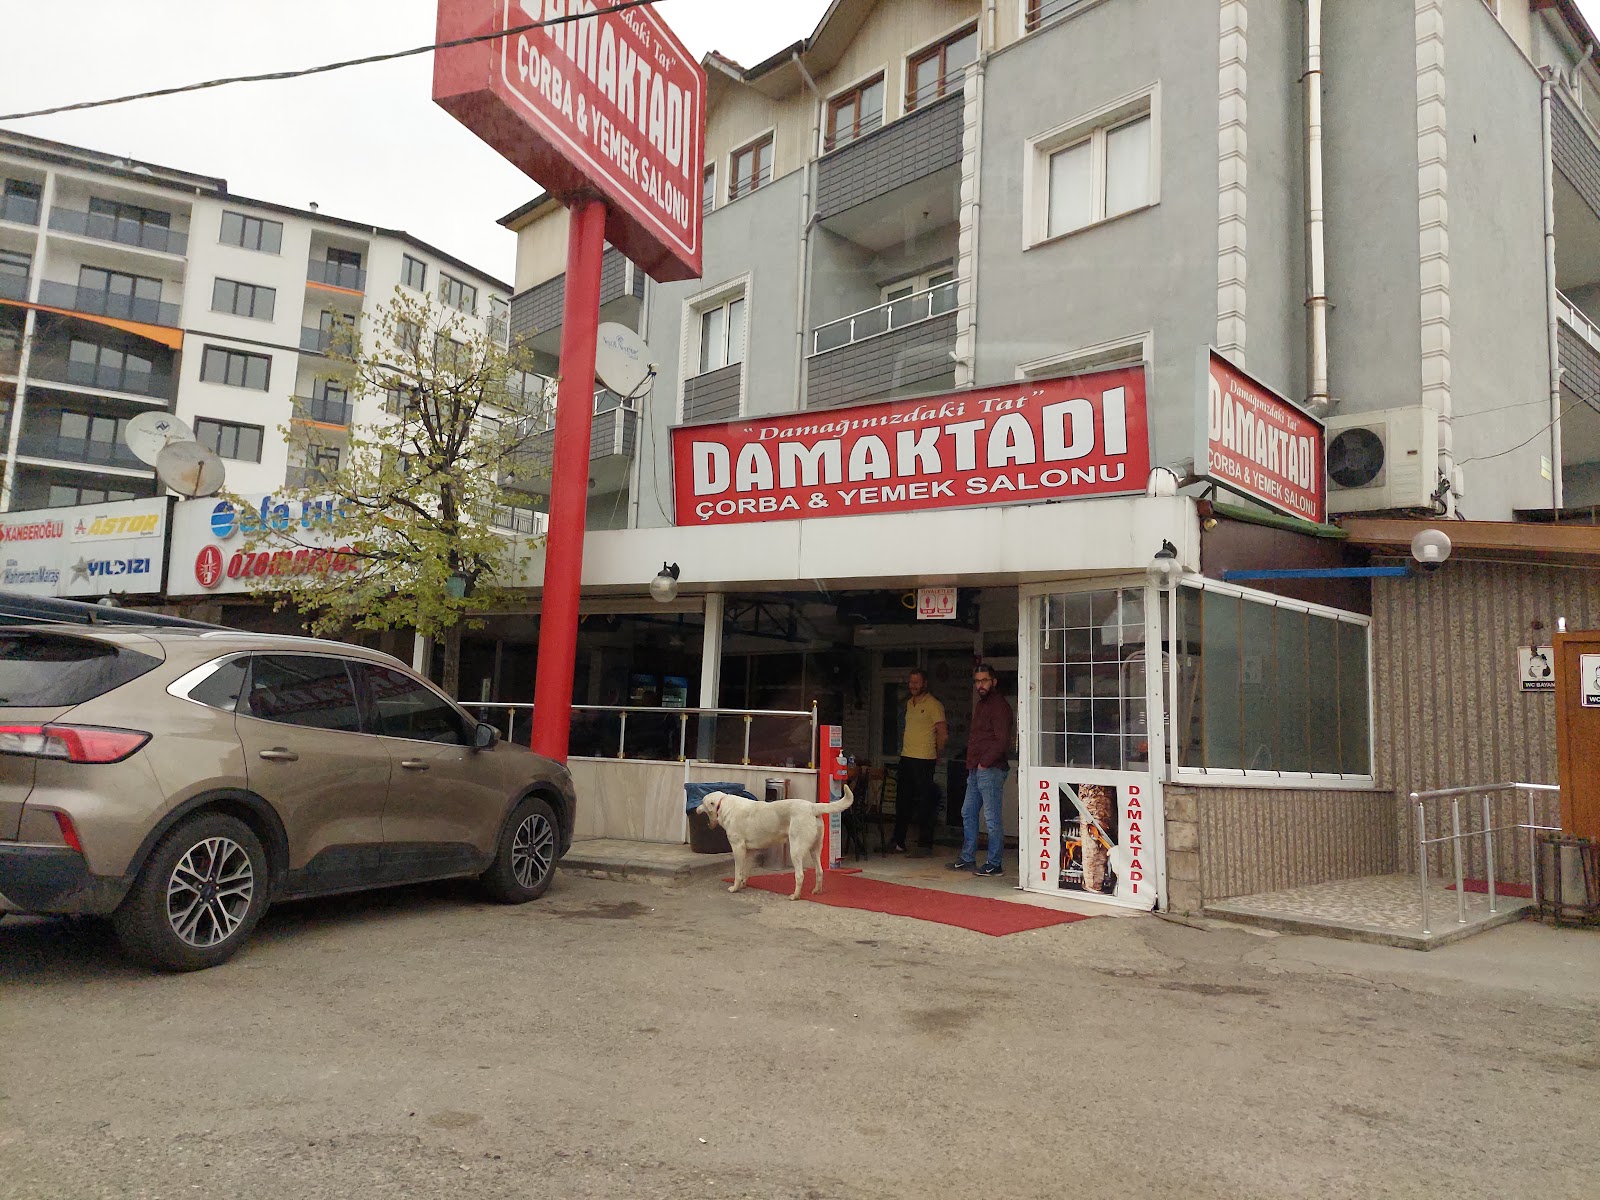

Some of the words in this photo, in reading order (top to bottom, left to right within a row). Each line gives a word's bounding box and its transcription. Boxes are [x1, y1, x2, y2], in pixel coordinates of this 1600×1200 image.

[517, 34, 574, 123] ÇORBA
[576, 93, 588, 136] &
[592, 104, 639, 185] YEMEK
[640, 156, 689, 230] SALONU
[519, 0, 692, 181] AMAKTADI
[692, 386, 1128, 496] DAMAKTADI
[1209, 371, 1315, 494] DAMAKTADI
[1209, 448, 1242, 481] ÇORBA
[1244, 466, 1250, 485] &
[1253, 471, 1283, 500] YEMEK
[1284, 487, 1316, 516] SALONU
[88, 515, 159, 535] ASTOR
[695, 495, 800, 521] ÇORBA
[808, 492, 829, 509] &
[837, 480, 956, 506] YEMEK
[966, 462, 1126, 496] SALONU
[87, 558, 151, 577] YILDIZI
[1039, 780, 1051, 881] DAMAKTADI
[1127, 785, 1143, 894] DAMAKTADI
